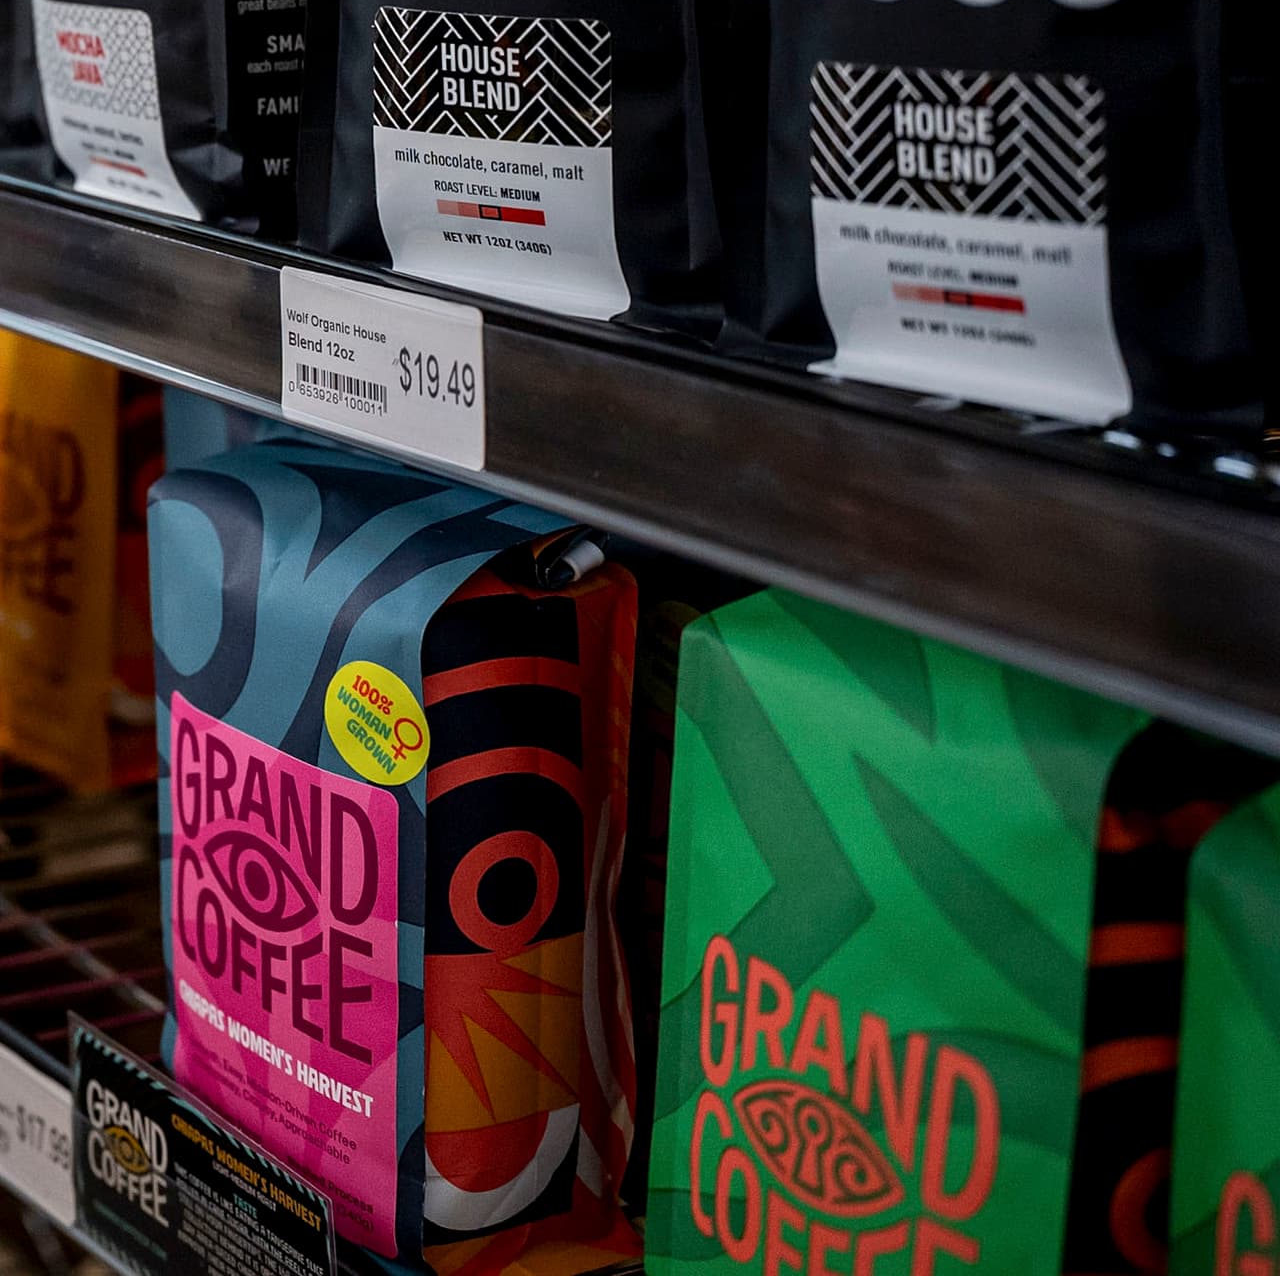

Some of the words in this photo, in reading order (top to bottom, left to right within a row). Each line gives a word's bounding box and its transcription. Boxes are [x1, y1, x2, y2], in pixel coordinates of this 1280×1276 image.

[267, 32, 306, 55] SMA
[441, 42, 521, 78] HOUSE
[247, 59, 272, 75] each
[256, 95, 299, 116] FAMI
[443, 76, 521, 112] BLEND
[893, 102, 995, 145] HOUSE
[395, 147, 421, 165] milk
[423, 151, 488, 173] chocolate,
[490, 159, 548, 180] caramel,
[552, 165, 585, 182] malt
[896, 140, 996, 185] BLEND
[434, 180, 464, 194] ROAST
[466, 184, 498, 198] LEVEL:
[500, 187, 541, 202] MEDIUM
[443, 230, 464, 244] NET
[465, 233, 483, 247] WT
[515, 239, 552, 255] (340G)
[840, 225, 871, 242] milk
[287, 308, 309, 325] Wolf
[311, 315, 351, 335] Organic
[353, 324, 387, 344] House
[288, 331, 322, 354] Blend
[326, 341, 356, 362] 12oz
[299, 383, 339, 405] 653926
[399, 346, 476, 408] $19.49
[337, 686, 392, 740] WOMAN
[352, 675, 394, 715] 100%
[346, 718, 397, 774] GROWN
[177, 718, 379, 927] GRAND
[178, 845, 373, 1066] COFFEE
[227, 1016, 293, 1076] WOMEN'S
[297, 1060, 374, 1118] HARVEST
[700, 934, 1000, 1221] GRAND
[86, 1079, 168, 1174] GRAND
[319, 1120, 357, 1151] Coffee
[88, 1130, 170, 1228] COFFEE
[216, 1145, 267, 1193] WOMEN'S
[269, 1183, 321, 1231] HARVEST
[232, 1193, 257, 1218] TASTE
